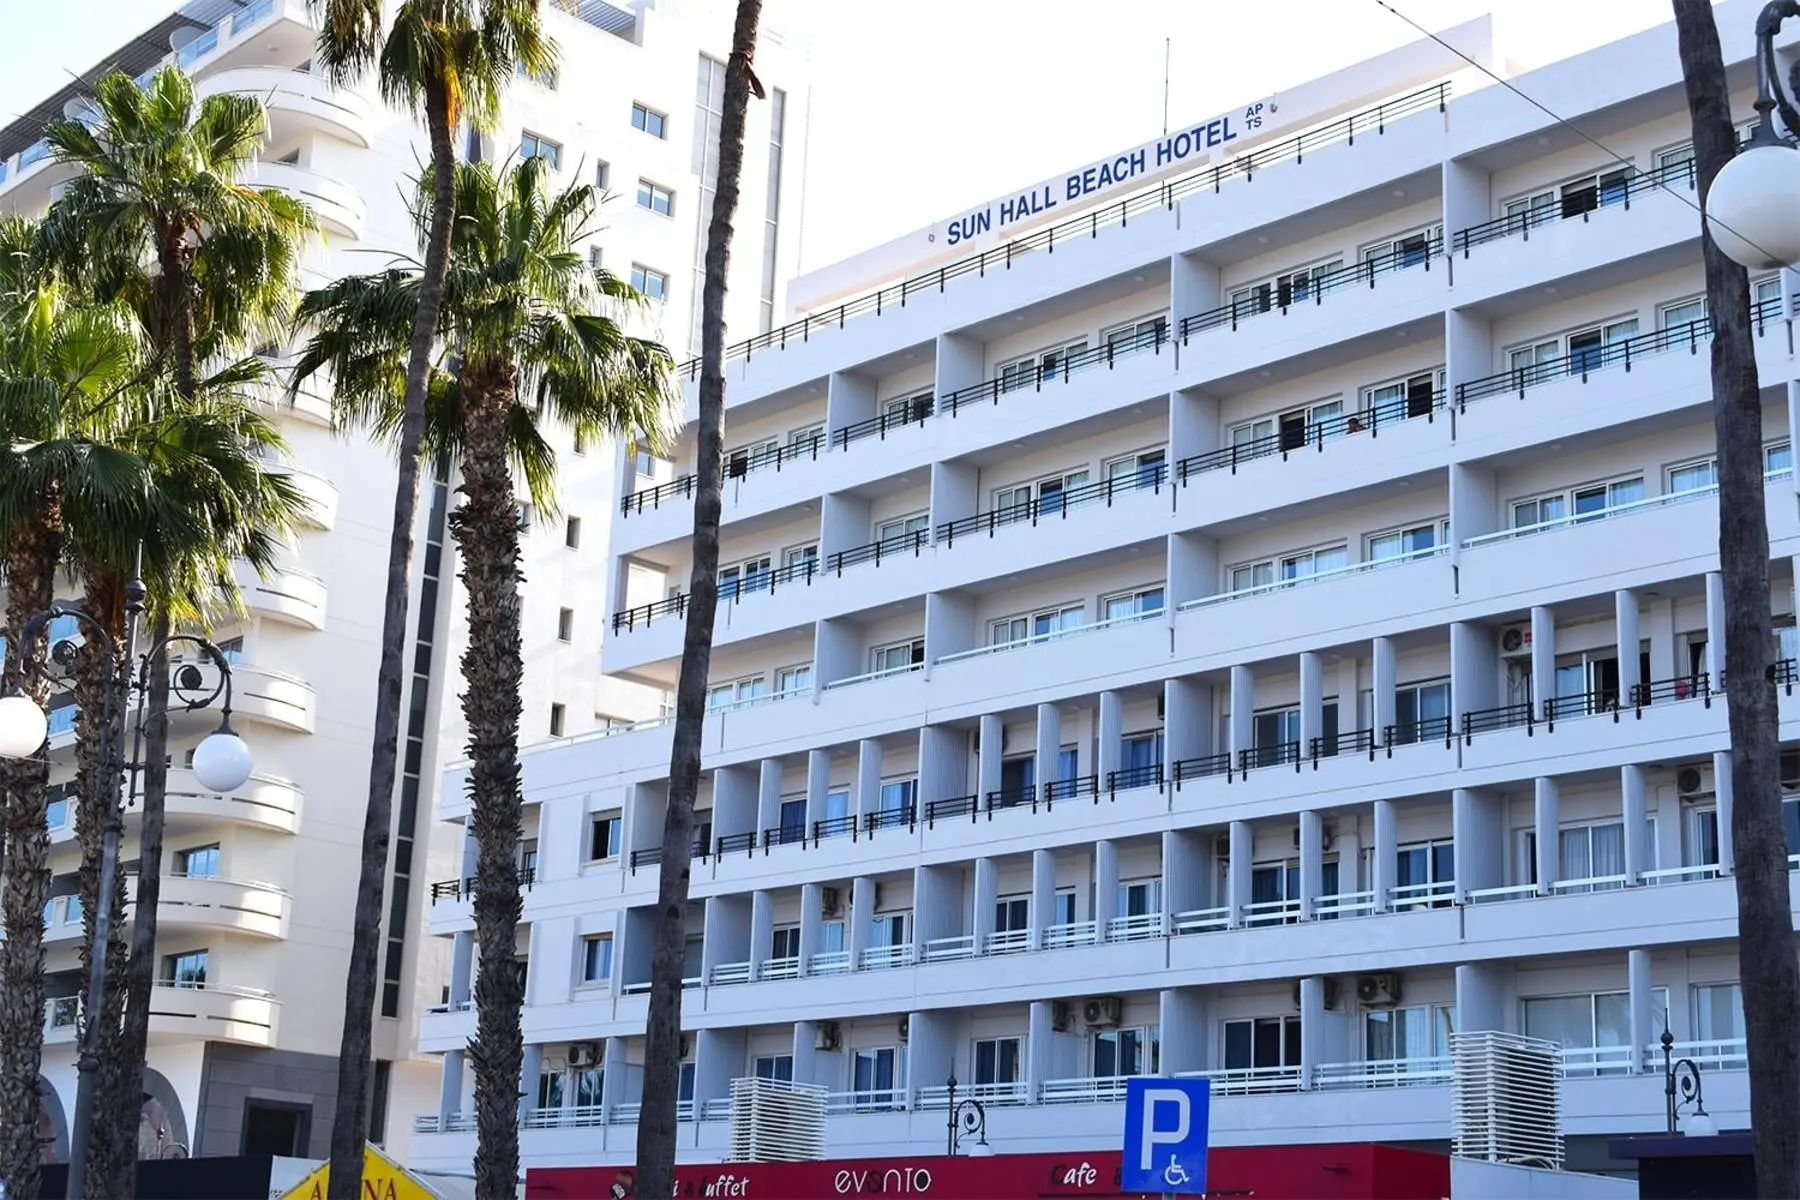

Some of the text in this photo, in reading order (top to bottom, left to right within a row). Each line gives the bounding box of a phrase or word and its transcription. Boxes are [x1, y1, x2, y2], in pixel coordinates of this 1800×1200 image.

[1245, 103, 1264, 119] AP
[1245, 116, 1263, 130] TS
[947, 117, 1237, 245] SUN HALL BEACH HOTEL
[1140, 1088, 1191, 1170] P
